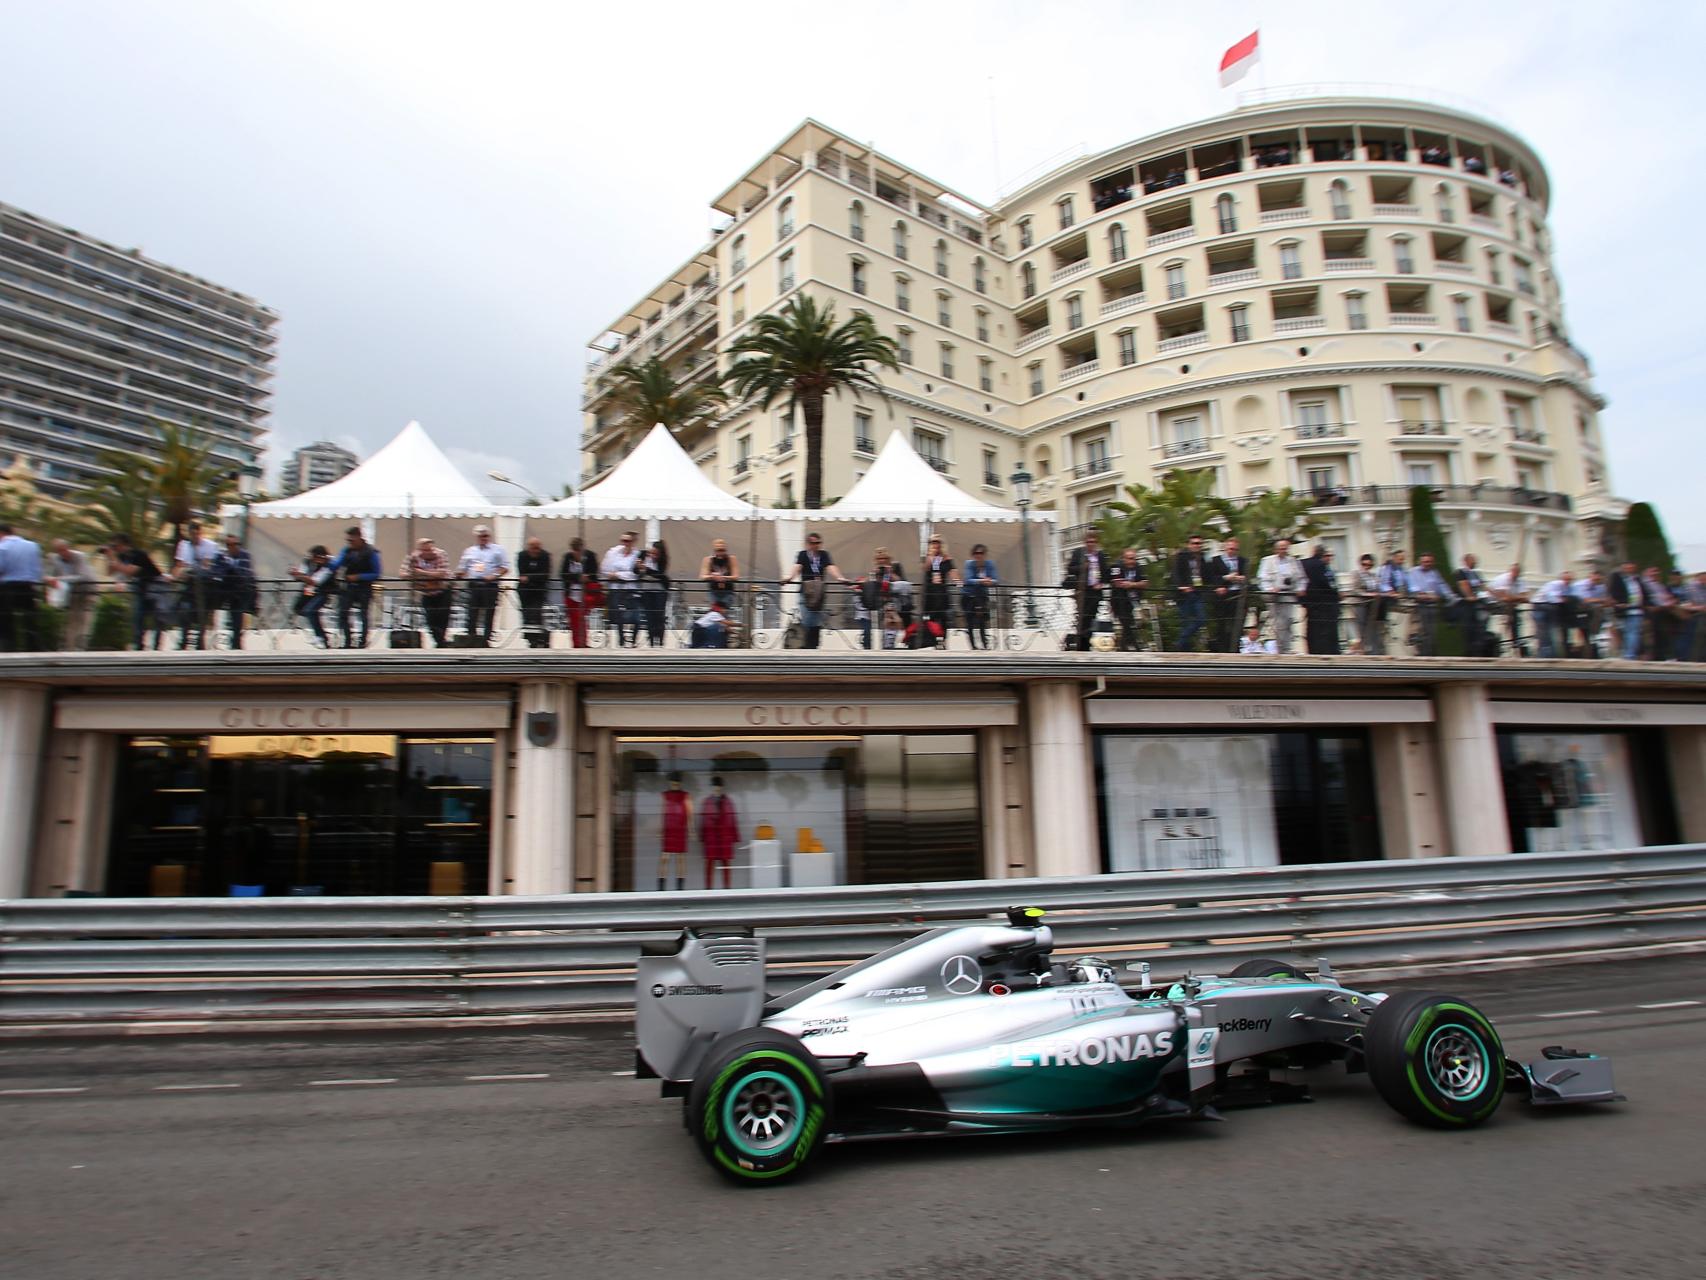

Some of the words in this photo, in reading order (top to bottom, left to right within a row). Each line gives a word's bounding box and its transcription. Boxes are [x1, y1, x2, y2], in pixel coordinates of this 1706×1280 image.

[219, 707, 352, 728] GUCCI
[744, 706, 870, 725] GUCCI
[1217, 1018, 1272, 1032] ackBerry
[989, 1031, 1174, 1067] PETRONAS
